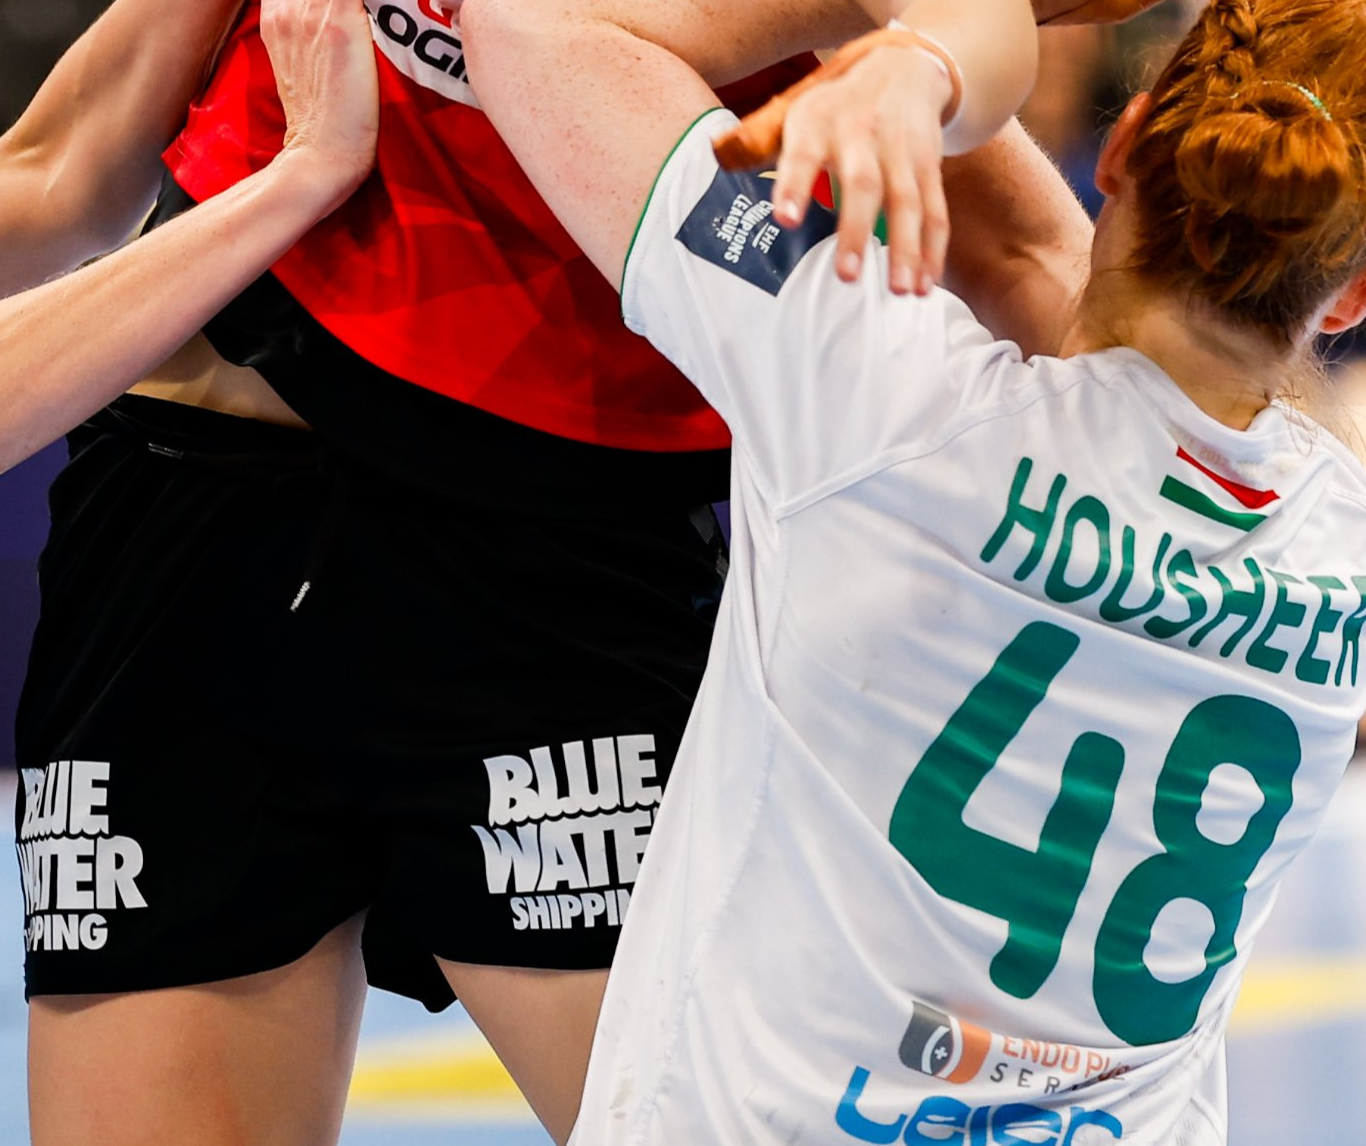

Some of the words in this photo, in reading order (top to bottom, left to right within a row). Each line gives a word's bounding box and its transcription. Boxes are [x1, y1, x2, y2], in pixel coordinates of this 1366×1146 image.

[758, 224, 781, 254] EHF
[482, 734, 663, 828] BLUE
[469, 806, 660, 895] WATE
[888, 620, 1302, 1047] 48
[1002, 1035, 1082, 1075] ENDO
